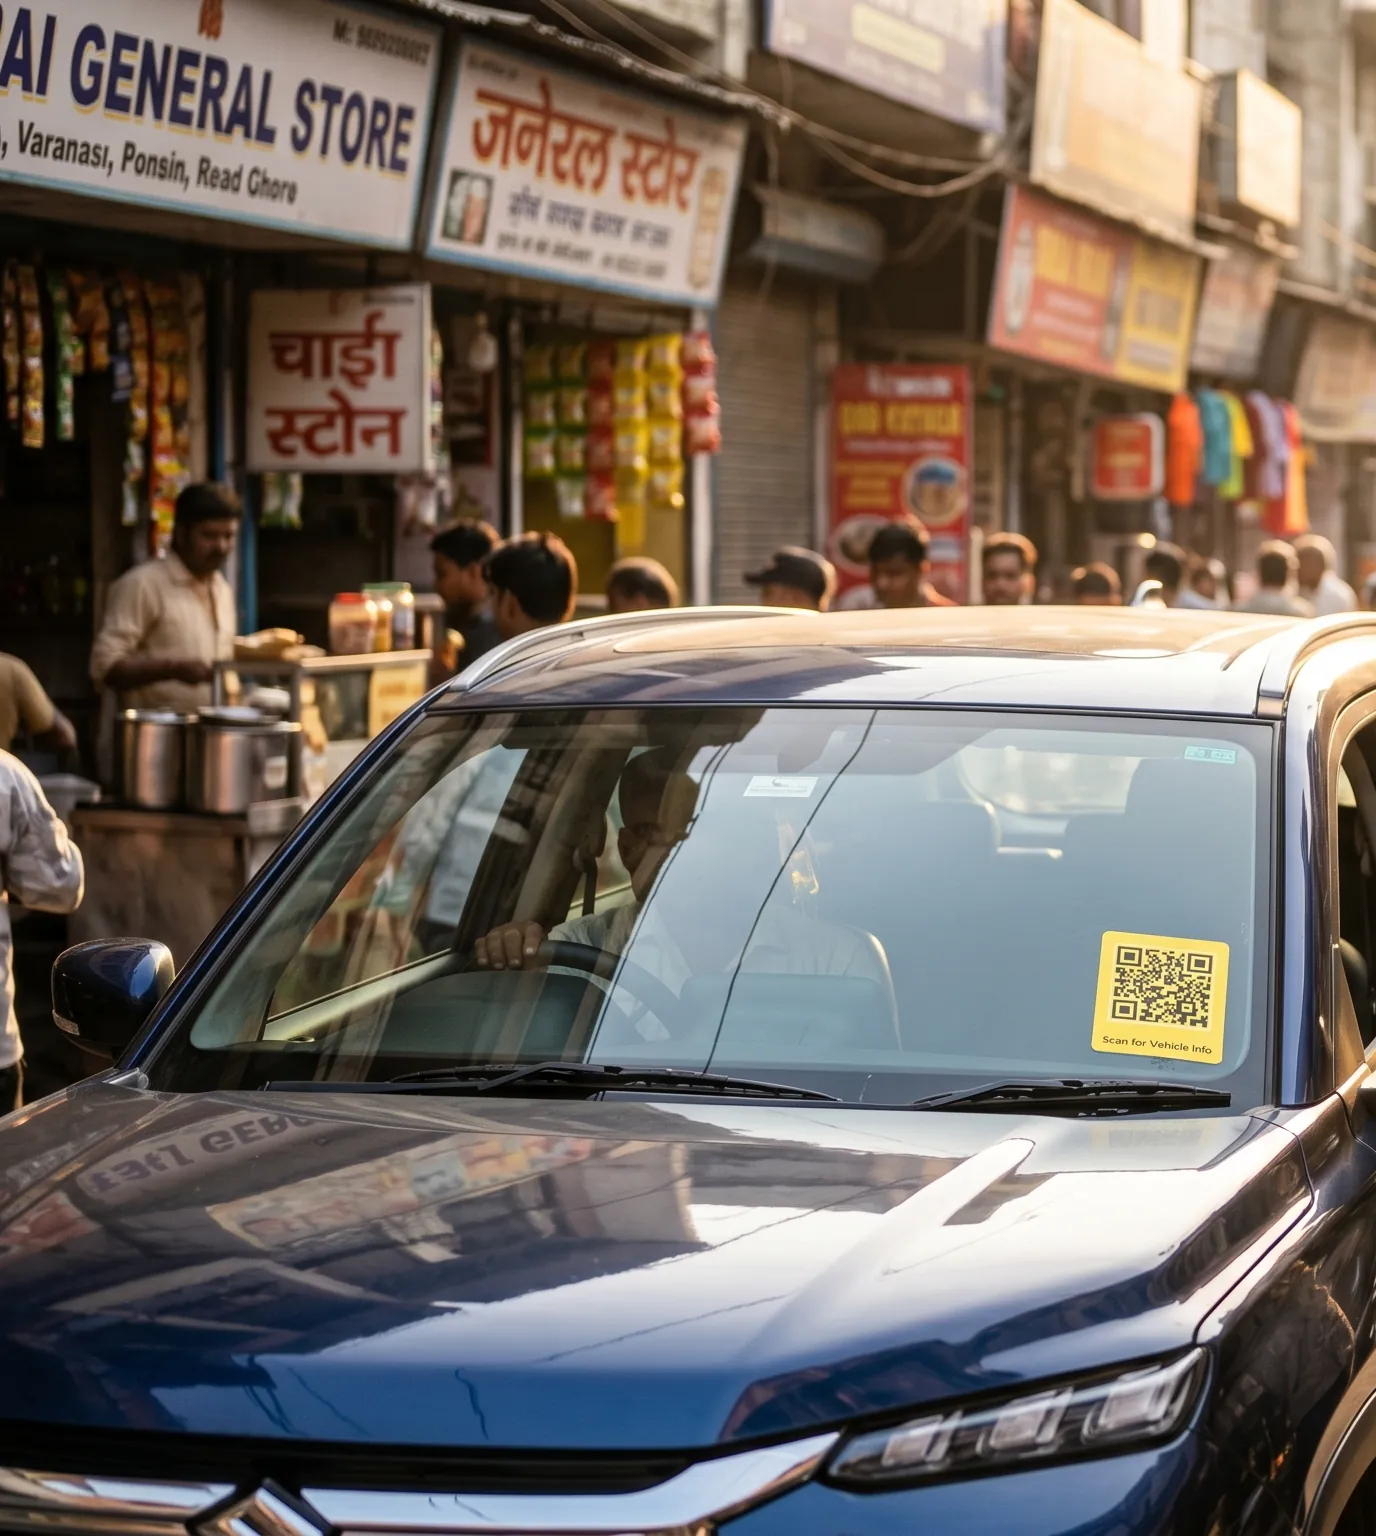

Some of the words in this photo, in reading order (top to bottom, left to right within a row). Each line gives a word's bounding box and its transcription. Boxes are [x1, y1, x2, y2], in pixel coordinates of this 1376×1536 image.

[0, 3, 57, 98] AI
[70, 23, 277, 145] GENERAL
[291, 78, 416, 173] STORE
[121, 140, 190, 191] Ponsin,
[196, 155, 243, 194] Read
[472, 77, 617, 196] जनेरल
[619, 117, 701, 213] स्टोर
[265, 387, 407, 459] स्टोन
[1102, 1035, 1128, 1045] Scan
[1131, 1038, 1147, 1047] for
[1149, 1040, 1189, 1052] Vehicle
[1192, 1044, 1212, 1055] Info
